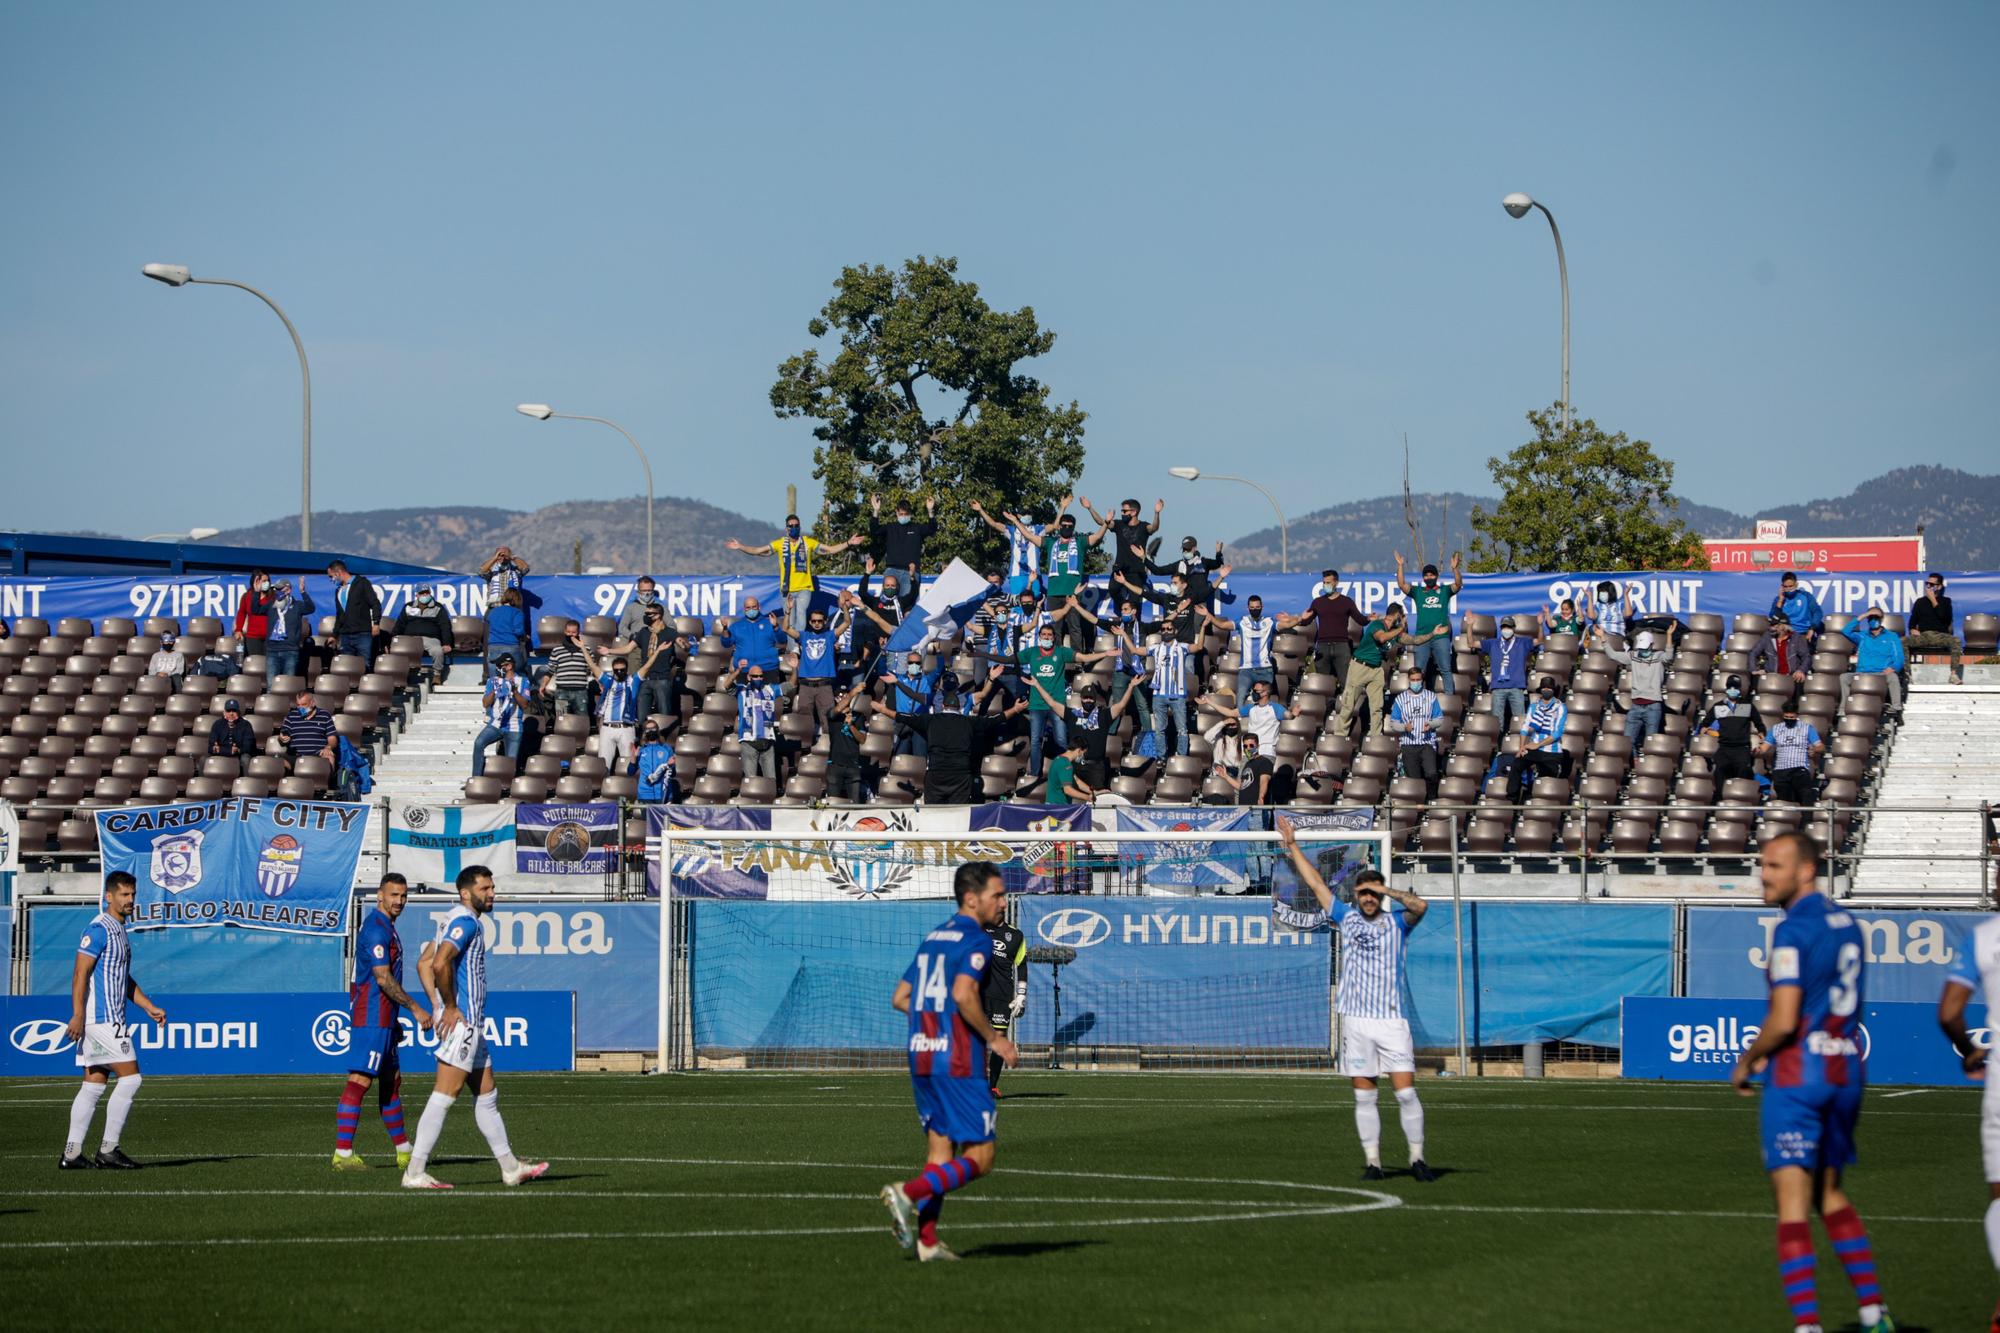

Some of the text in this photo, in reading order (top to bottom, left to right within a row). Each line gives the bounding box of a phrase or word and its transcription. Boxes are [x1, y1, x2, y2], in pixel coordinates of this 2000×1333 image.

[1760, 525, 1784, 537] MALLA
[105, 797, 362, 833] CARDIFF CITY
[408, 834, 467, 848] FANATIKS
[915, 953, 948, 1012] 14
[1829, 943, 1861, 1016] 3
[463, 1027, 474, 1046] 2
[910, 1032, 949, 1052] fibwi
[367, 1050, 382, 1071] 11
